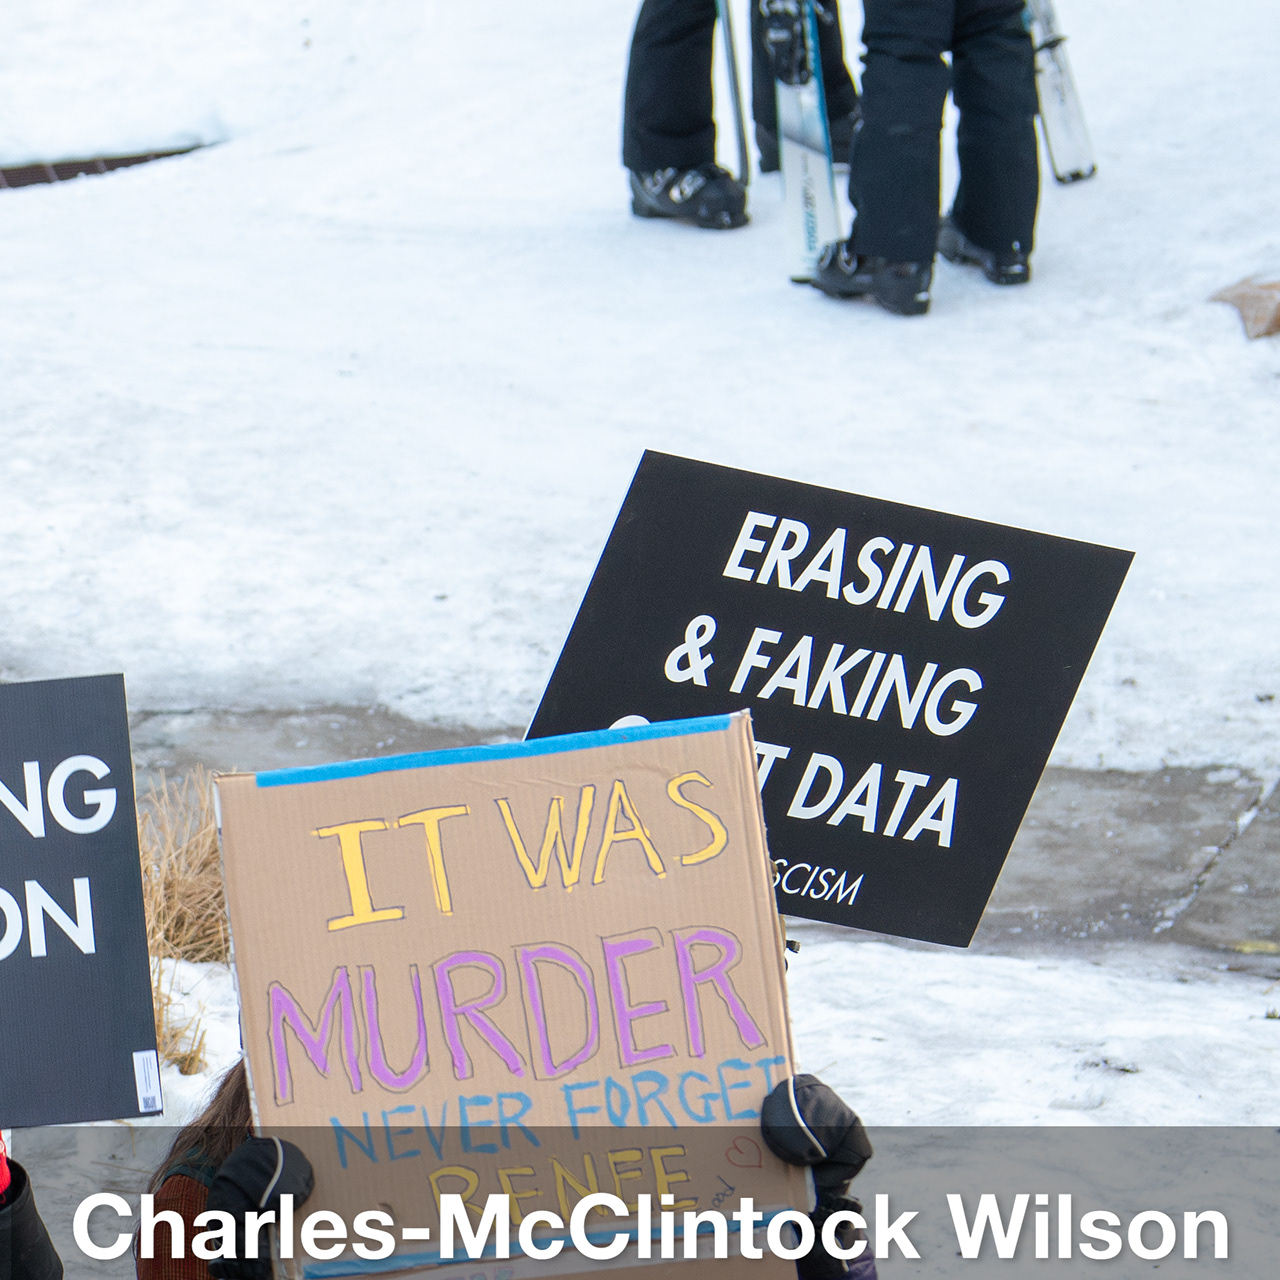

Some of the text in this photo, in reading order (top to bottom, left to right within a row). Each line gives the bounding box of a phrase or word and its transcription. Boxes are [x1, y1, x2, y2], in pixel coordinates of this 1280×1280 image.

[722, 510, 1010, 628] ERASING
[663, 614, 984, 736] & FAKING
[311, 769, 729, 931] IT WAS
[786, 752, 960, 848] DATA
[268, 925, 770, 1106] MURDER
[329, 1054, 788, 1169] NEVER FORGET
